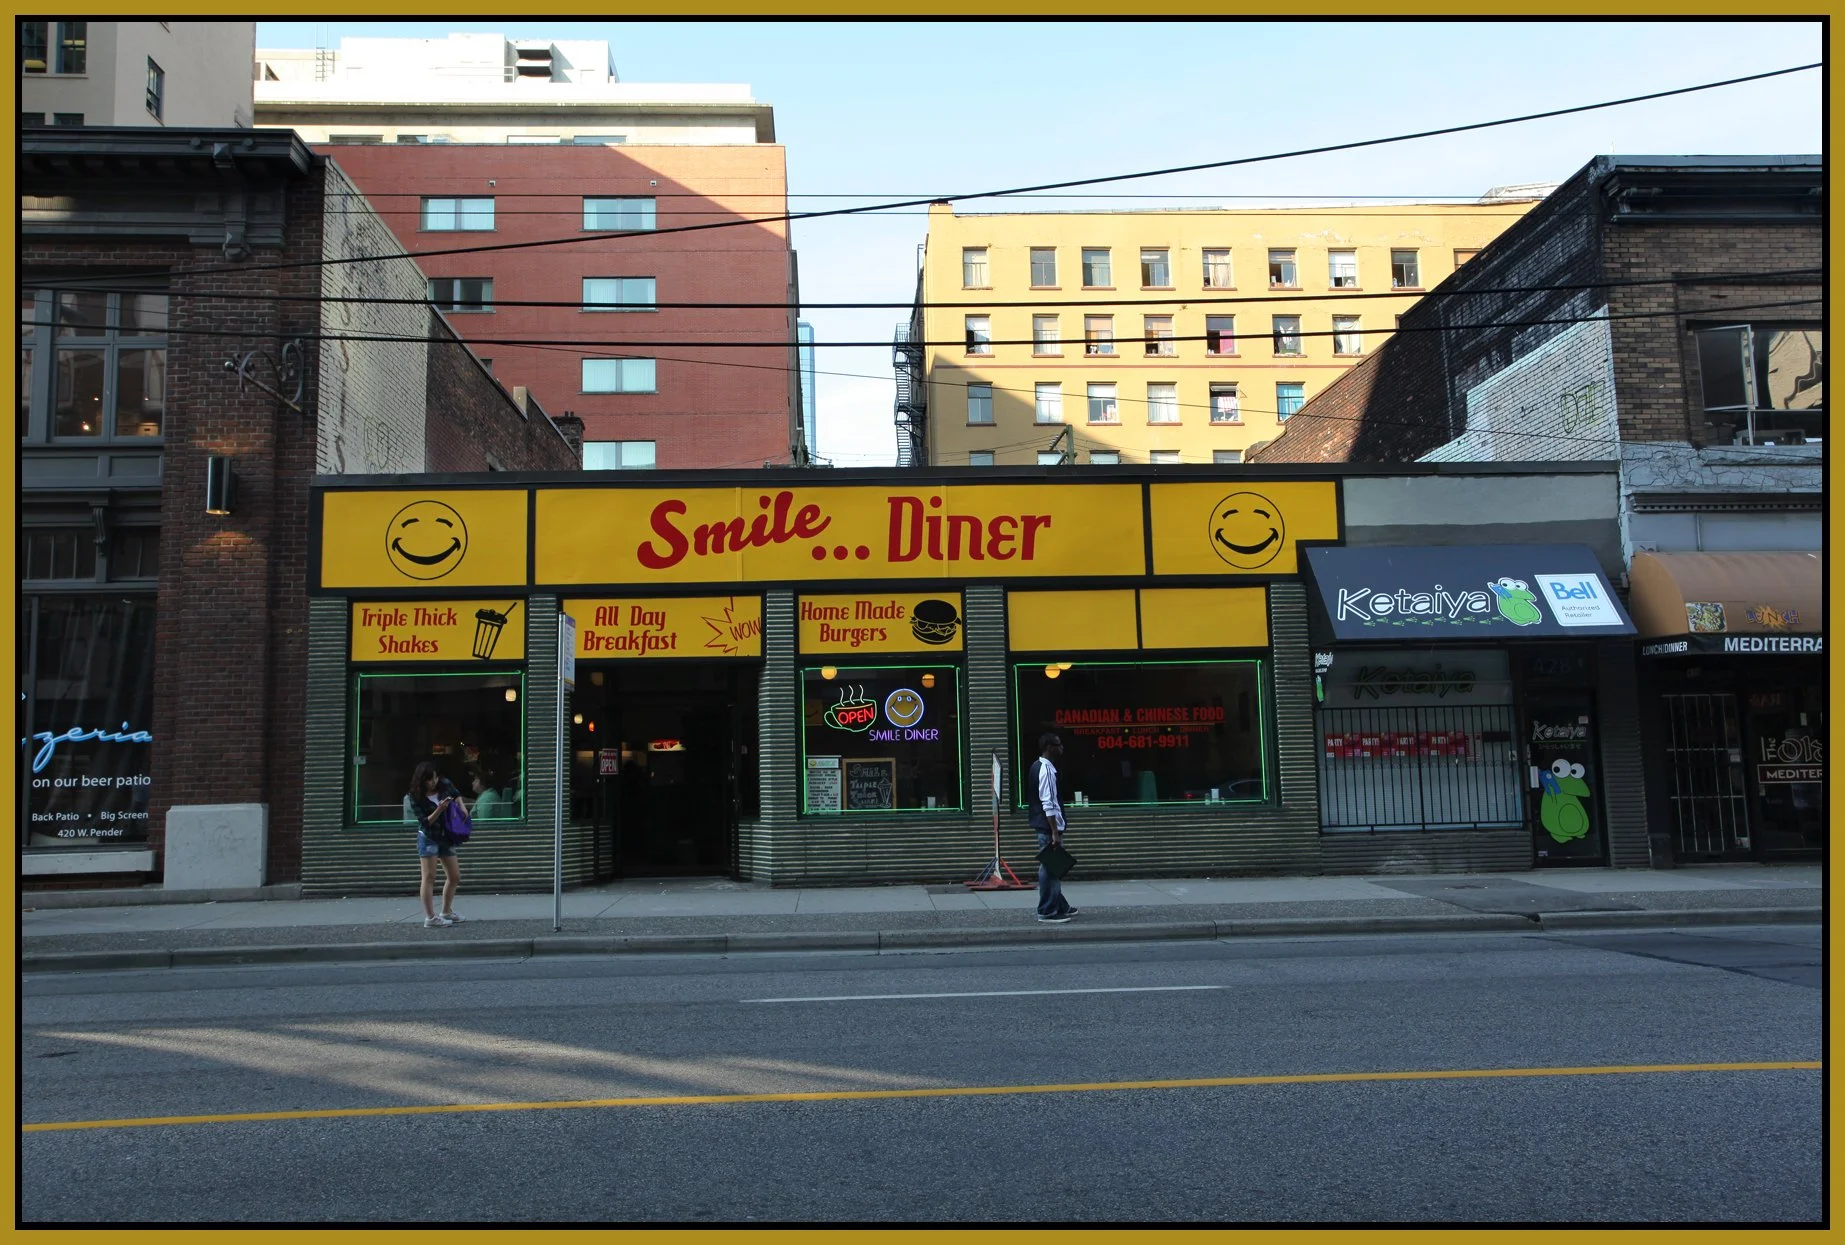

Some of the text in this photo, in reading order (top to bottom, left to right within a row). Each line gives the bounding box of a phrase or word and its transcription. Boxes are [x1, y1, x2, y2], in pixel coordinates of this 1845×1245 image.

[886, 495, 1052, 563] Diner
[1550, 581, 1598, 600] Bell
[800, 600, 906, 622] Home Made
[1337, 584, 1491, 622] Ketaiya
[1561, 603, 1601, 611] Authorized
[361, 607, 458, 632] Triple Thick
[594, 605, 667, 632] All Day
[728, 615, 762, 642] WOW
[378, 634, 440, 655] Shakes
[583, 629, 678, 656] Breakfast
[818, 622, 888, 648] Burgers
[1354, 664, 1476, 700] Ketaiya
[837, 707, 875, 725] OPEN
[1055, 706, 1225, 724] CANADIAN & CHINESE FOOD
[868, 728, 939, 742] SMILE DINER
[1073, 727, 1121, 736] BREAKFAST
[1532, 721, 1587, 741] Ketaiya
[22, 721, 152, 773] zeria
[1097, 734, 1190, 750] 604-681-9911
[600, 760, 617, 772] OPEN
[32, 774, 152, 789] on our beer patio
[32, 811, 149, 822] Back Patio Big Screen
[57, 828, 123, 838] 420 W. Pender
